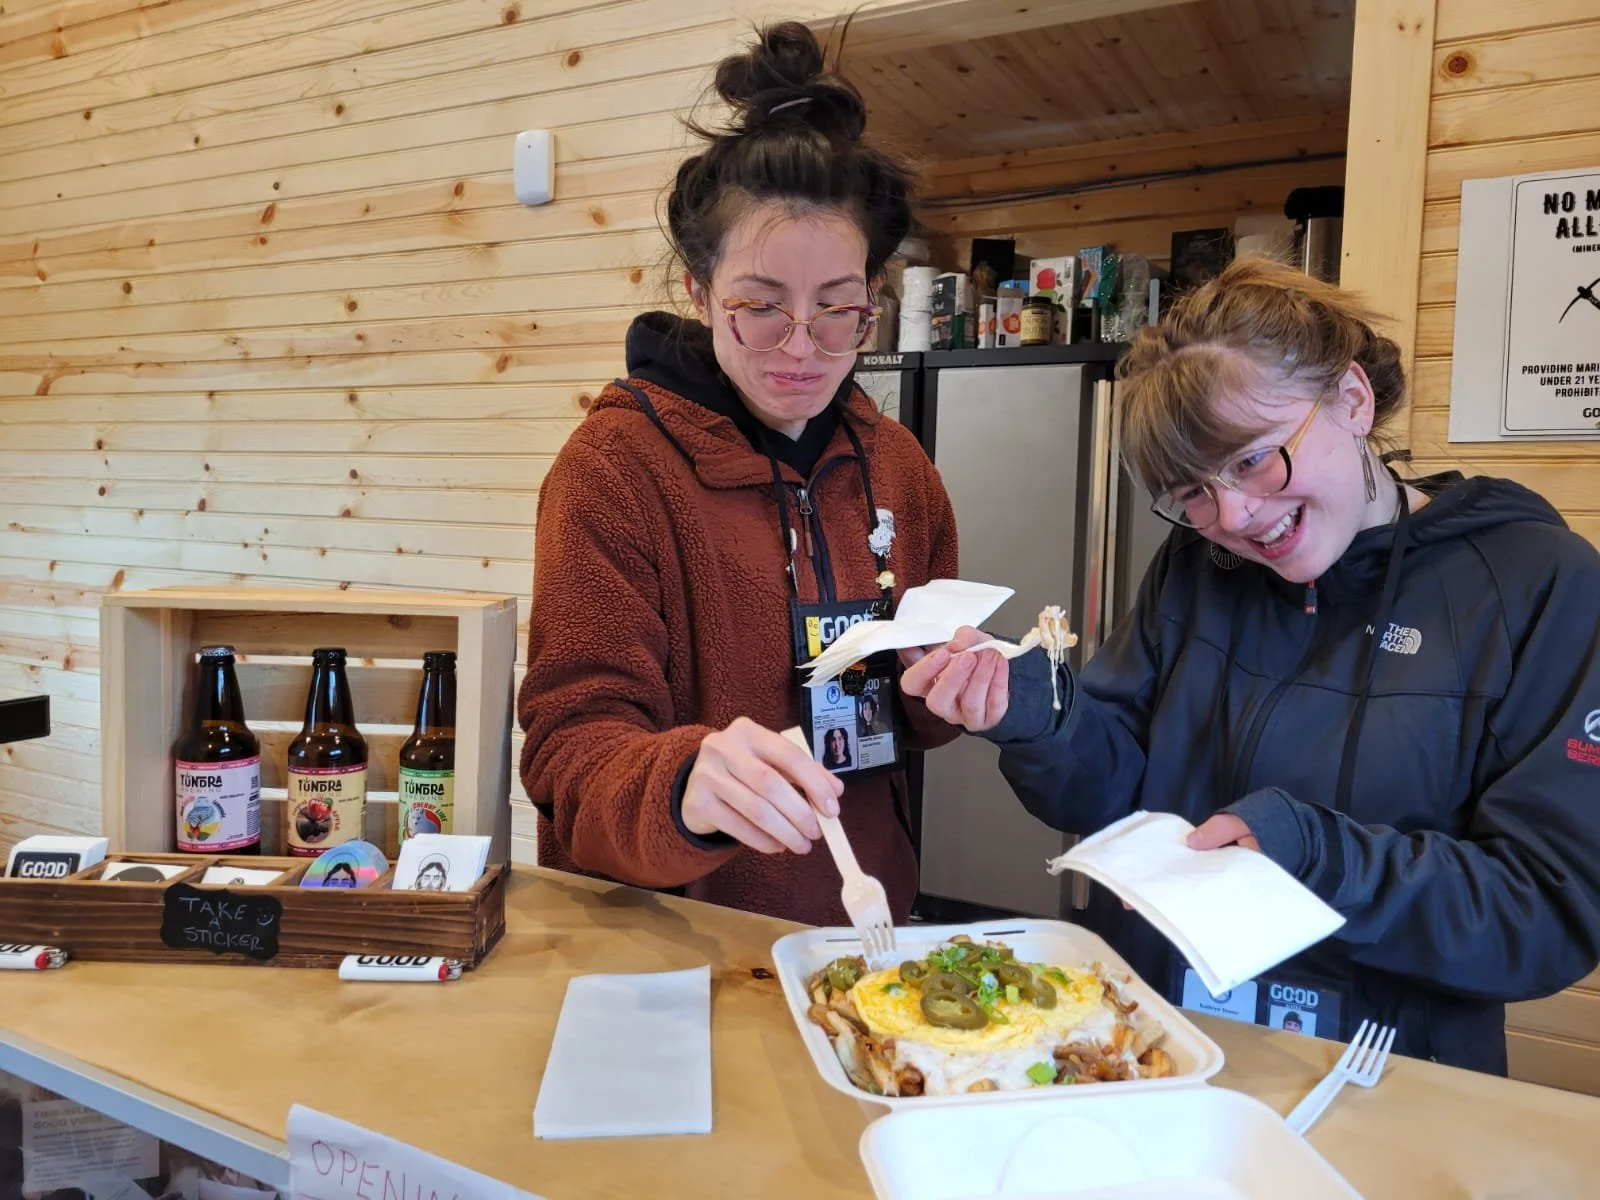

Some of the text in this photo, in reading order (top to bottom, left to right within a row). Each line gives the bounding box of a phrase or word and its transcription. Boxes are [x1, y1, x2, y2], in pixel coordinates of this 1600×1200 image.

[1543, 191, 1576, 215] NO
[1555, 215, 1600, 239] ALL
[863, 354, 904, 366] KOBALT
[1521, 362, 1600, 375] PROVIDING MARI
[1540, 374, 1600, 386] UNDER 21 YE
[1555, 387, 1600, 398] PROHIBIT
[1582, 407, 1600, 418] GO
[1365, 624, 1407, 645] NRTH
[1389, 622, 1411, 636] THE
[1379, 640, 1406, 654] ACE
[181, 773, 223, 788] TUNDRA
[298, 778, 343, 793] TUNDRA
[405, 780, 445, 796] TUNDRA
[21, 860, 69, 878] GOOD
[178, 896, 248, 920] TAKE
[208, 917, 221, 931] A
[183, 926, 265, 951] STICKER
[1270, 983, 1319, 1007] GOOD
